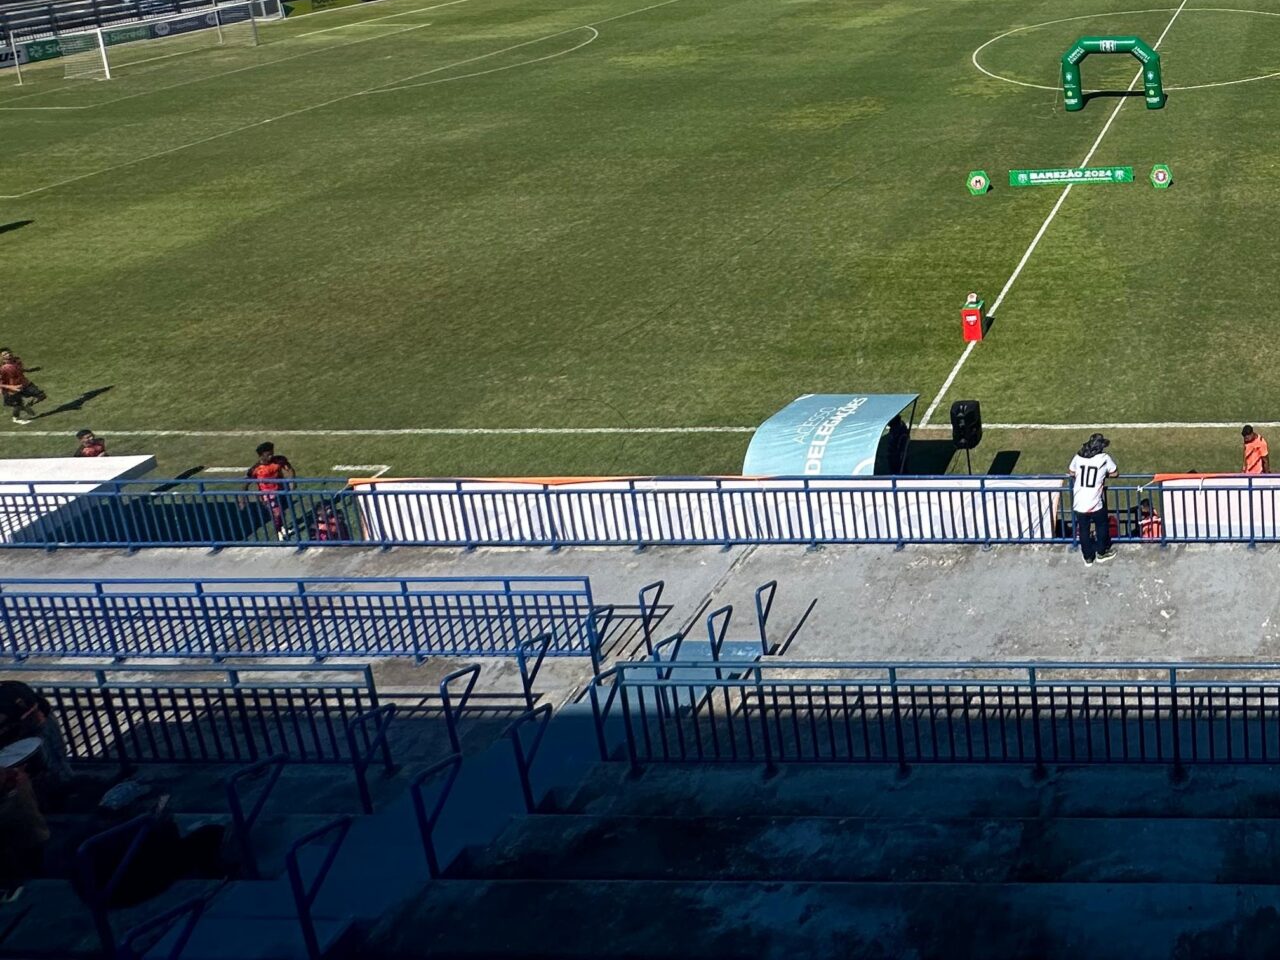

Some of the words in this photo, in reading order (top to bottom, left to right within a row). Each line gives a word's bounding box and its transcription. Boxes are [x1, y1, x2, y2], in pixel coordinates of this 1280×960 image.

[1029, 169, 1082, 180] BAREZÃO
[1084, 169, 1113, 178] 2024
[792, 406, 838, 444] ACESSO
[1080, 465, 1098, 488] 10
